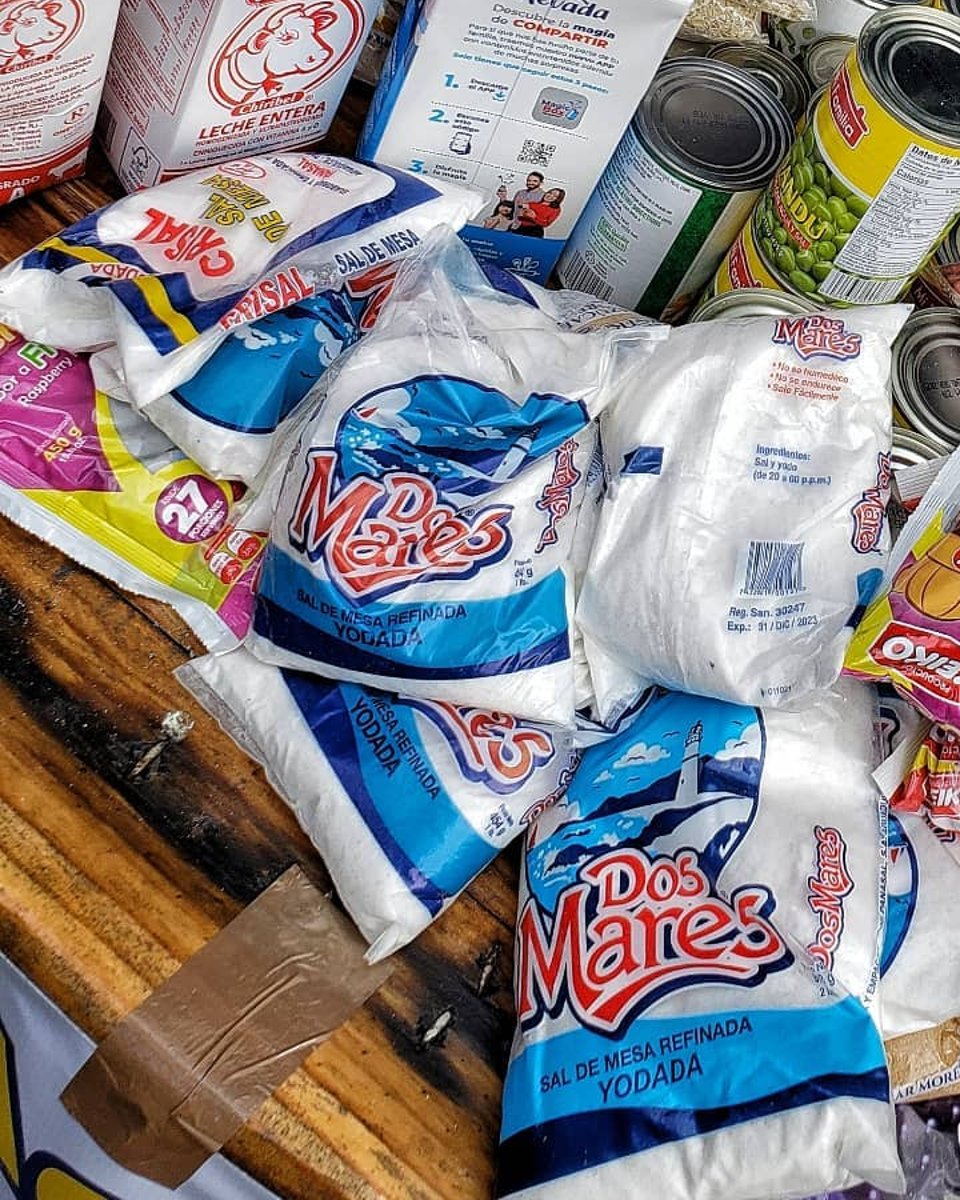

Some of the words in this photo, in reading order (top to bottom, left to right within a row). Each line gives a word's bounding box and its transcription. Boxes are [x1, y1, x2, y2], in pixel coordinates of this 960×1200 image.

[493, 4, 556, 26] Descubre
[558, 18, 570, 29] la
[572, 24, 616, 40] magia
[513, 18, 610, 50] COMPARTIR
[443, 74, 460, 89] 1.
[199, 117, 258, 141] LECHE
[259, 101, 326, 126] ENTERA
[428, 108, 450, 124] 2.
[408, 159, 428, 175] 3.
[911, 145, 939, 161] Datos
[9, 187, 25, 203] A
[334, 246, 367, 276] SAL
[362, 240, 383, 264] DE
[380, 228, 420, 257] MESA
[773, 317, 862, 360] Mares
[811, 316, 845, 332] Dos
[17, 353, 75, 406] Raspberry
[754, 457, 769, 467] Sal
[777, 461, 798, 471] yodo
[756, 444, 811, 461] Ingredientes:
[753, 471, 767, 482] (de
[768, 471, 780, 481] 20
[160, 479, 207, 526] 27
[292, 453, 514, 595] Mares
[321, 603, 338, 618] DE
[340, 608, 383, 627] MESA
[388, 605, 467, 626] REFINADA
[727, 621, 752, 634] Exp.:
[728, 606, 748, 619] Reg.
[750, 607, 773, 618] San.
[775, 602, 805, 617] 30247
[334, 623, 425, 648] YODADA
[350, 698, 401, 779] YODADA
[394, 730, 442, 800] REFINADA
[586, 849, 708, 908] Dos
[810, 826, 850, 907] Mares
[519, 887, 783, 1028] Mares
[540, 1071, 573, 1094] SAL
[575, 1063, 600, 1087] DE
[604, 1046, 656, 1075] MESA
[659, 1016, 753, 1056] REFINADA
[599, 1056, 704, 1103] YODADA
